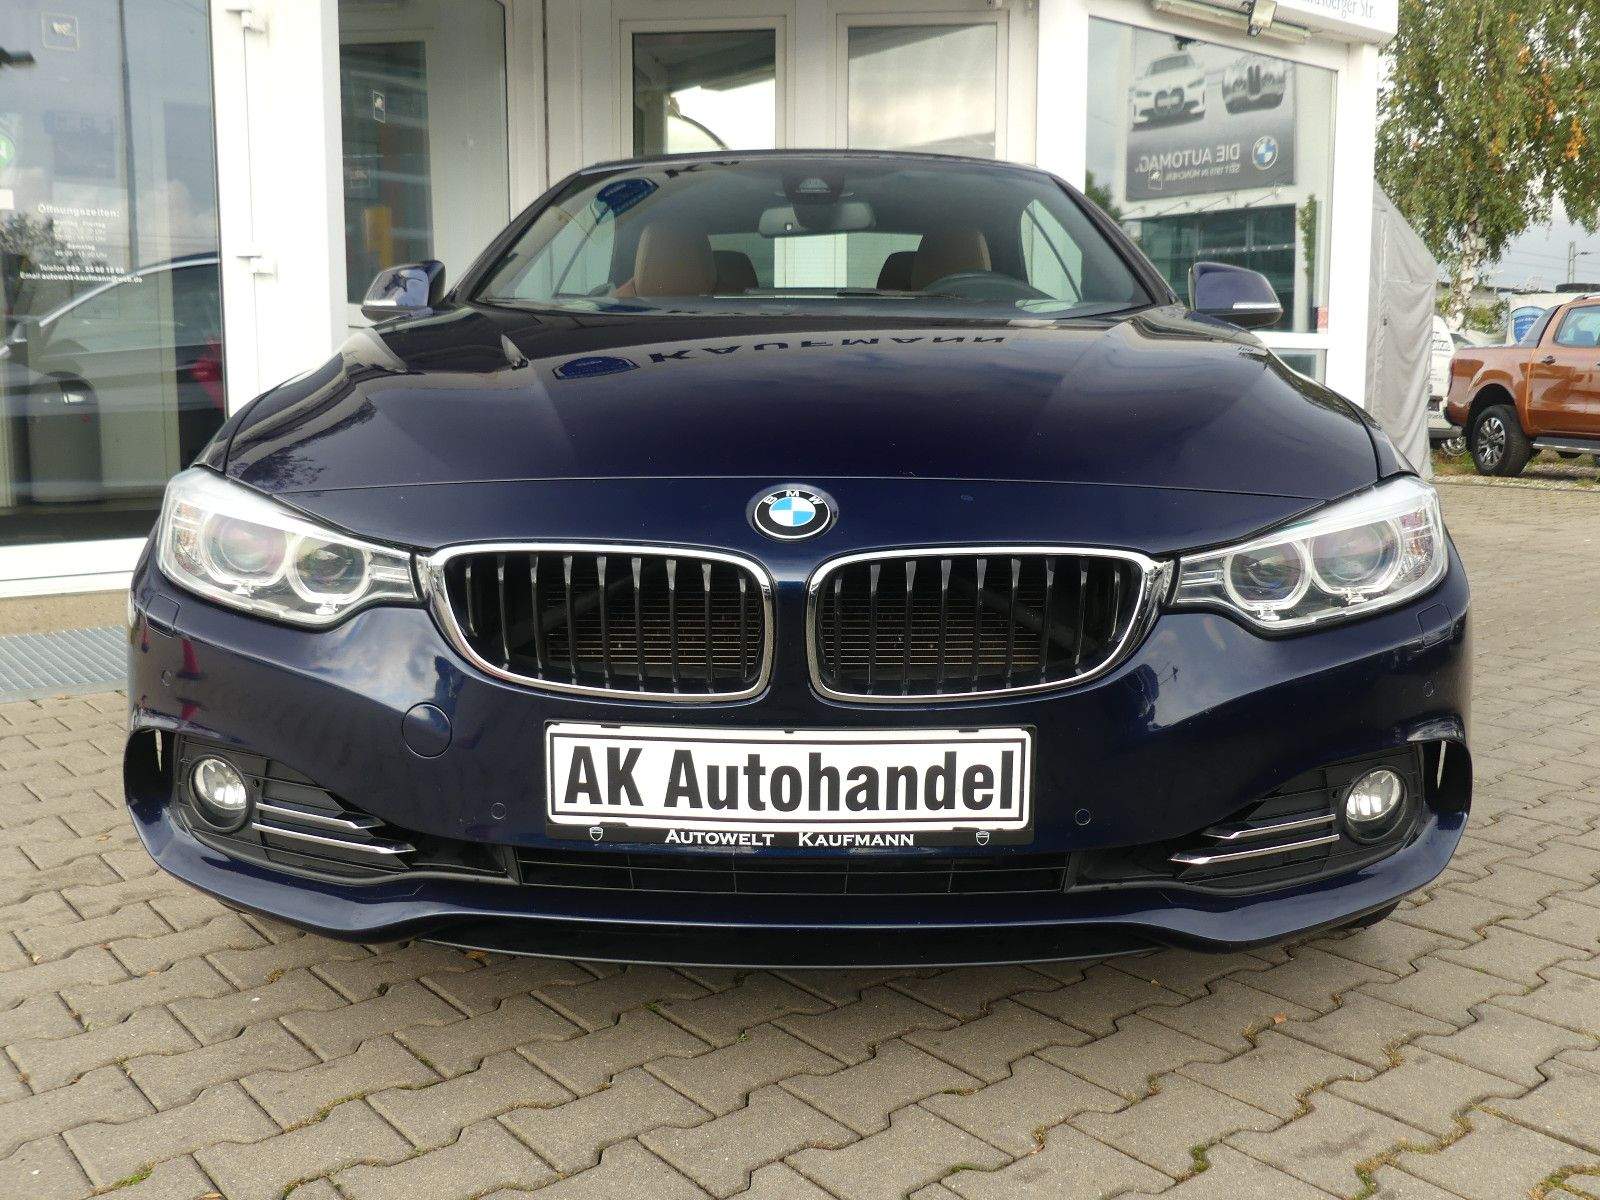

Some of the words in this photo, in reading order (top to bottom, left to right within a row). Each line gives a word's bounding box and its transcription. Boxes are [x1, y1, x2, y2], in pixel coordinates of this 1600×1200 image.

[564, 745, 644, 807] AK
[663, 749, 1014, 812] Autohandel
[665, 829, 775, 846] AUTOWELT
[798, 831, 914, 847] KAUFMANN
